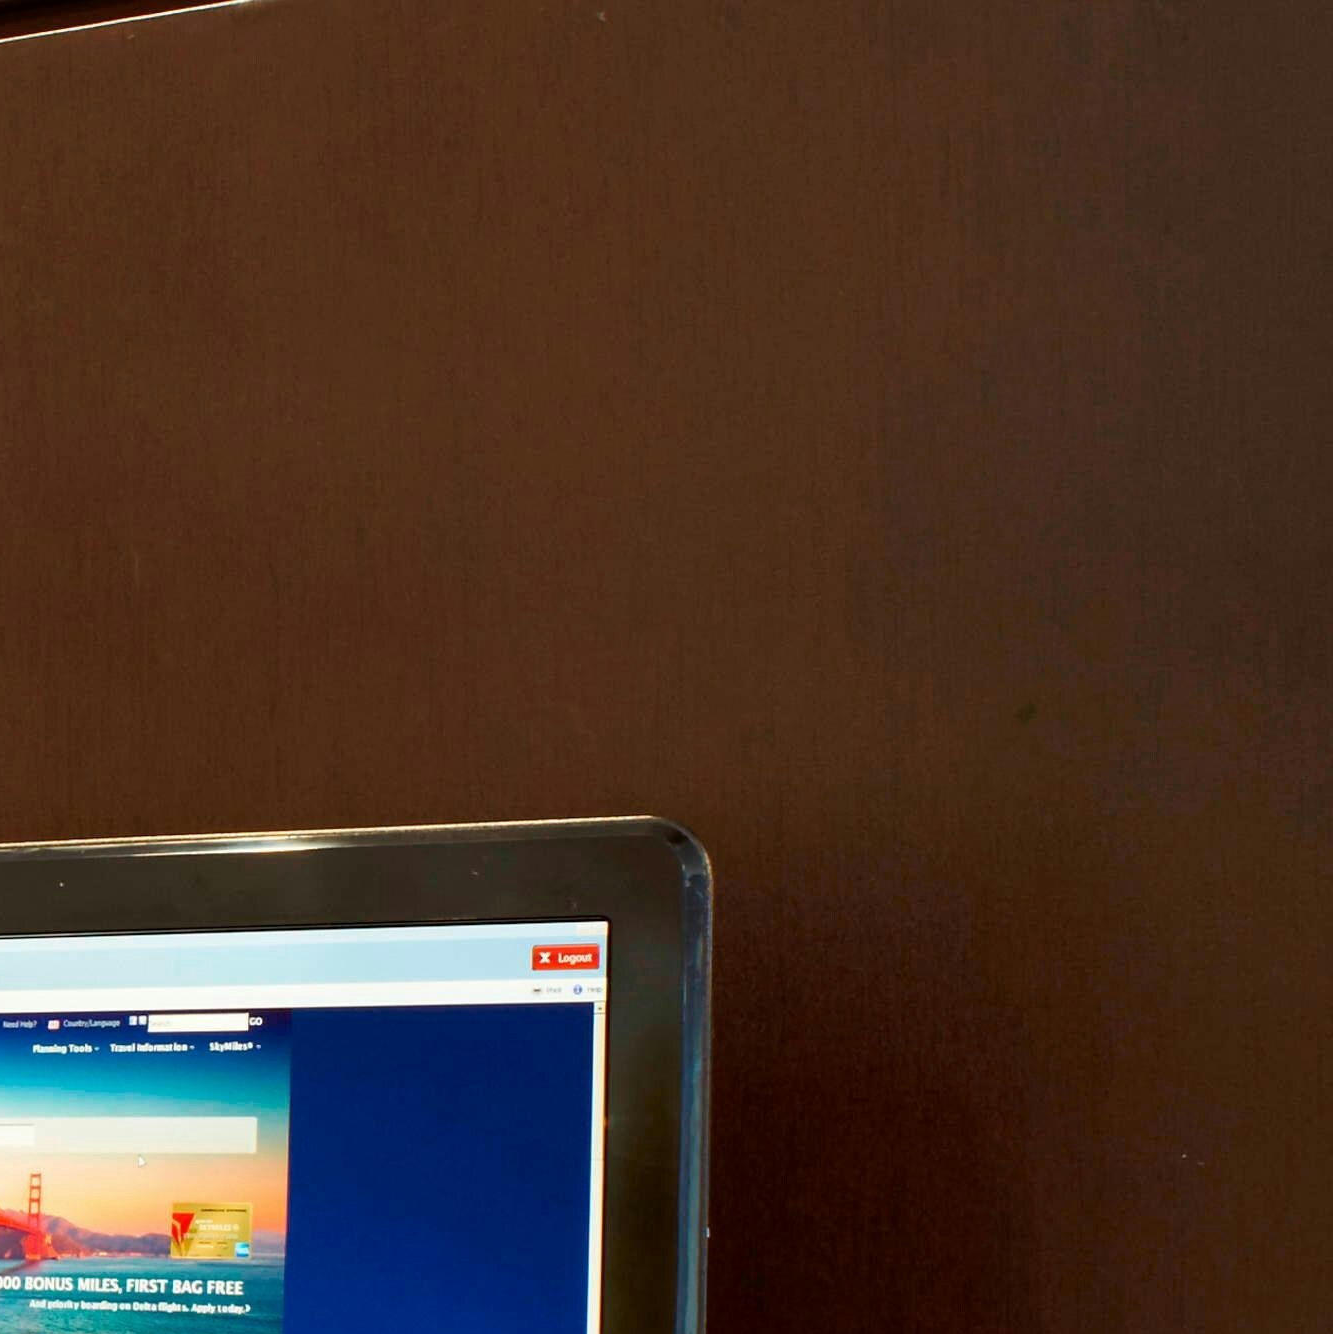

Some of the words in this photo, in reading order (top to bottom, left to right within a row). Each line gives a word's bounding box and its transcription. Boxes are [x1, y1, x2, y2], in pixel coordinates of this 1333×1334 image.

[558, 953, 592, 965] Logout
[248, 1016, 263, 1026] GO
[24, 1276, 74, 1291] BONUS
[78, 1278, 122, 1293] MILES,
[126, 1279, 168, 1293] FIRST
[172, 1280, 203, 1294] BAG
[207, 1280, 243, 1295] FREE
